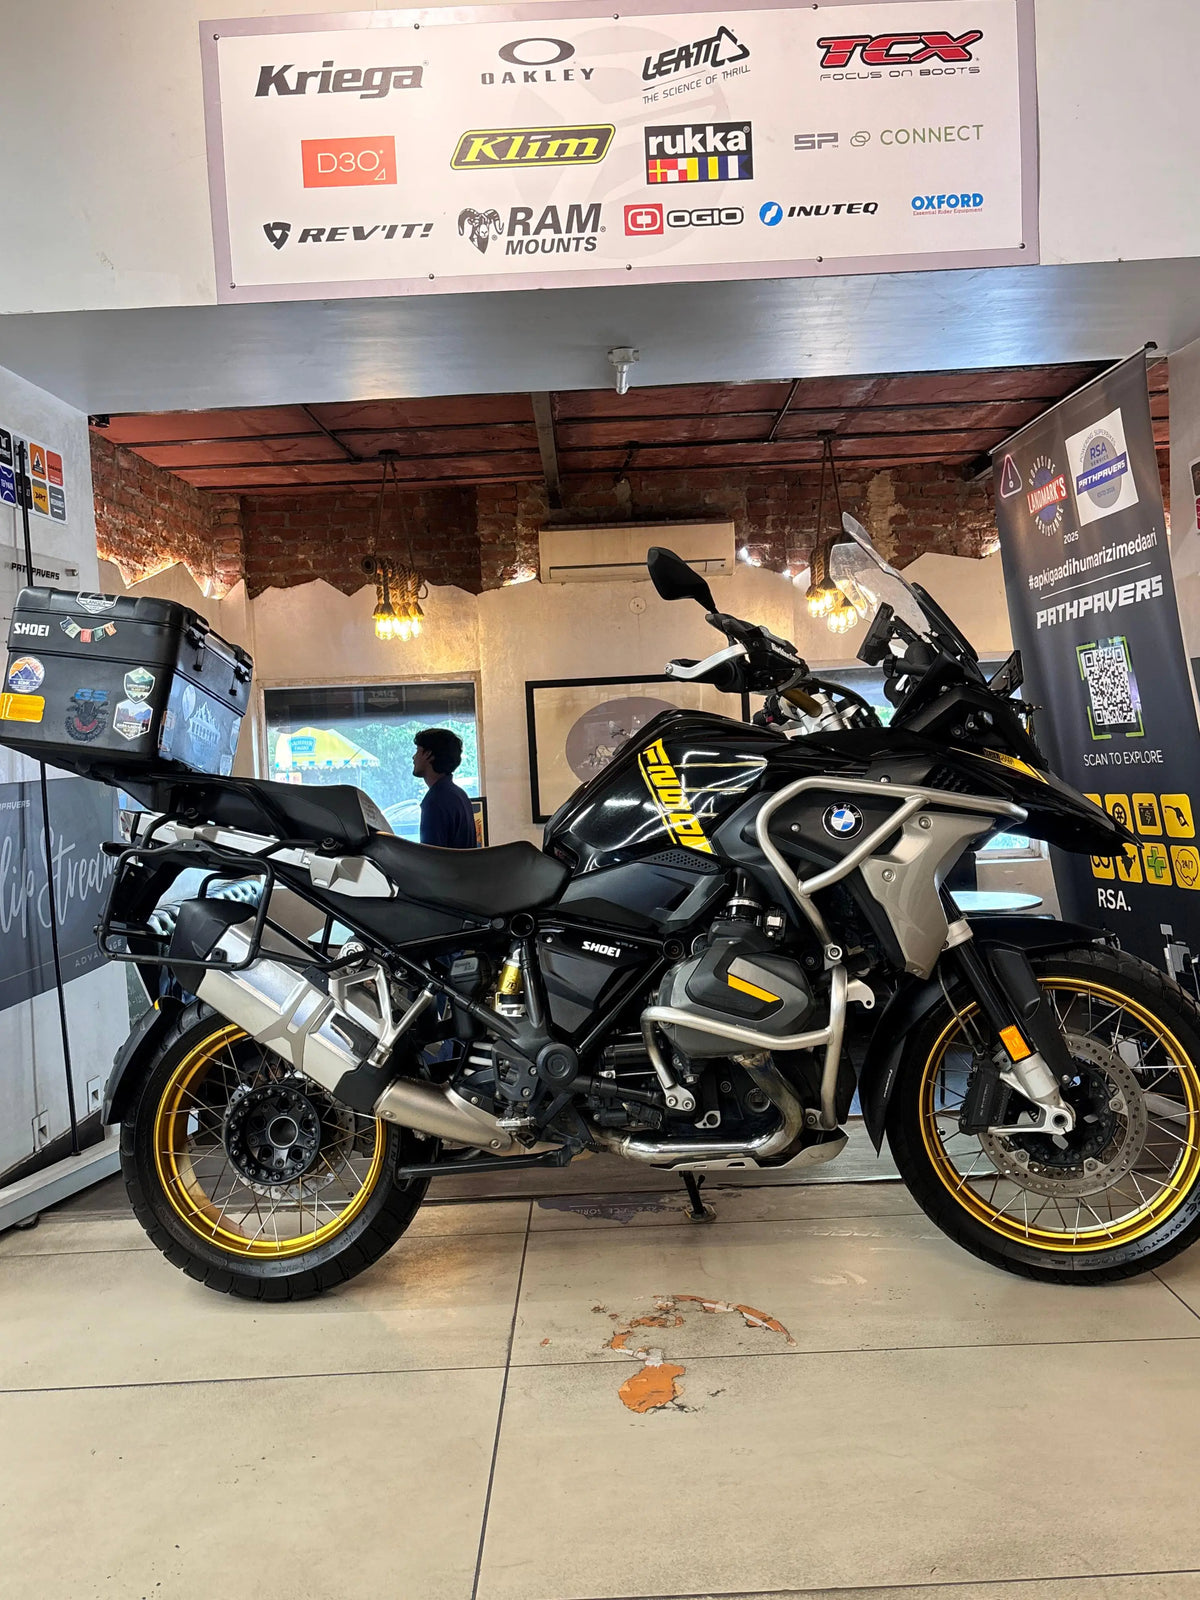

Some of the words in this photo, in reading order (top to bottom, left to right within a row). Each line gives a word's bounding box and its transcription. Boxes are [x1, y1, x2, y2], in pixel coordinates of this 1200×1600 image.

[817, 29, 983, 69] TCX
[255, 61, 423, 99] Kriega
[481, 68, 594, 85] OAKLEY
[642, 92, 660, 104] THE
[662, 78, 702, 98] SCIENCE
[705, 74, 718, 85] OF
[722, 64, 751, 80] THRILL
[820, 71, 882, 81] FOCUS
[919, 66, 981, 77] BOOTS
[648, 125, 748, 157] rukka
[794, 132, 839, 151] SP
[880, 124, 984, 146] CONNECT
[787, 201, 879, 217] INUTEQ
[911, 192, 984, 211] OXFORD
[506, 203, 602, 237] RAM
[666, 206, 744, 228] OGIO
[297, 222, 434, 244] REV'IT!
[505, 236, 598, 256] MOUNTS
[1090, 442, 1108, 461] RSA
[1028, 455, 1056, 486] ROADSIDE
[1078, 459, 1126, 489] PATHPAVERS
[1026, 476, 1067, 515] LANDMARK'S
[1034, 505, 1064, 537] ASSISTANCE
[1063, 530, 1079, 545] 2025
[1028, 527, 1158, 591] #apkigaadihumarizimedaari
[11, 562, 60, 580] PATPAVERS
[1036, 574, 1164, 630] PATHPAVERS
[13, 622, 50, 637] SHOEI
[1083, 752, 1109, 767] SCAN
[1109, 751, 1122, 765] TO
[1122, 749, 1164, 764] EXPLORE
[1097, 887, 1132, 912] RSA.
[581, 941, 621, 958] SHOEI
